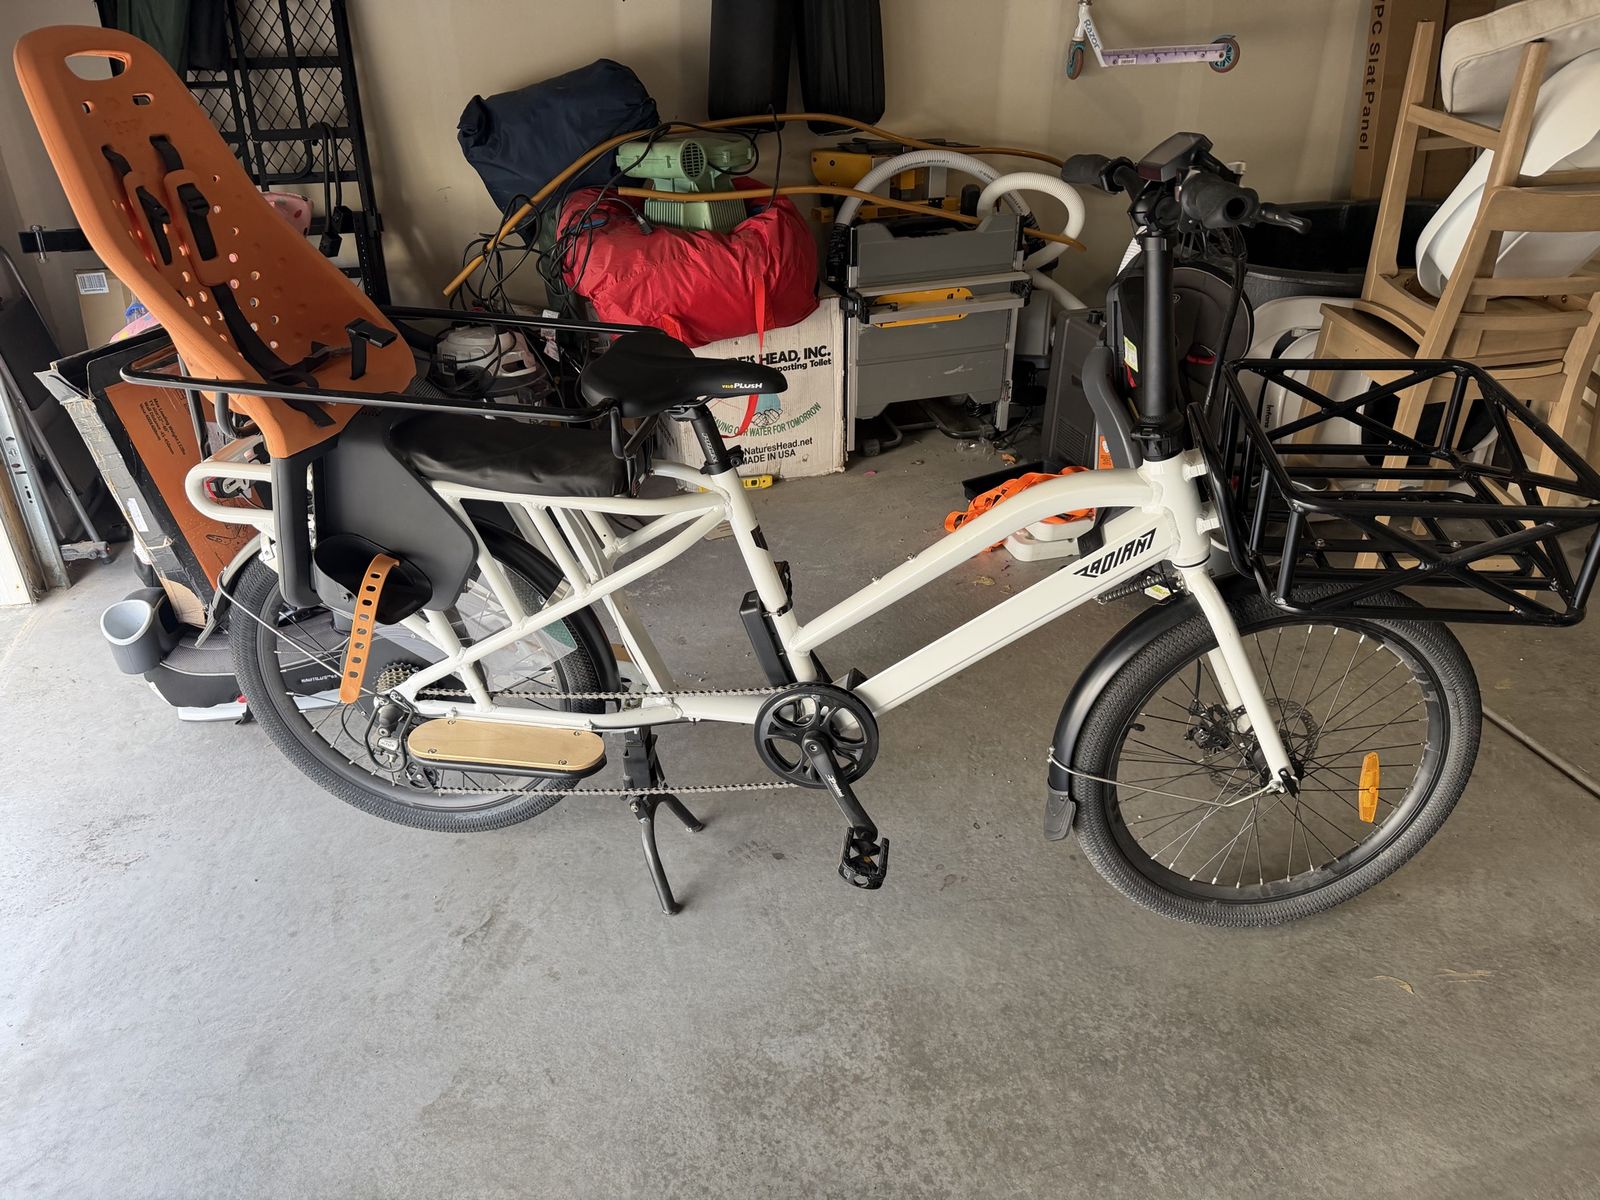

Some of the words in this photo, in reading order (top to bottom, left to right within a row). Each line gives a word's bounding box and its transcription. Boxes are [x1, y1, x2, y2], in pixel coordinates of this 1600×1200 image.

[1084, 18, 1101, 49] Razor
[1370, 0, 1385, 35] PC
[1366, 42, 1381, 85] Slat
[1358, 91, 1375, 150] Panel
[759, 349, 801, 366] HEAD,
[803, 345, 832, 360] INC.
[809, 357, 832, 368] Toilet
[749, 425, 773, 437] WATER
[773, 422, 787, 435] FOR
[786, 402, 822, 430] TOMORROW
[741, 453, 766, 465] MADE
[767, 451, 777, 461] IN
[778, 449, 797, 459] USA
[744, 437, 813, 456] NaturesHead.net
[1073, 528, 1157, 578] RADIANT
